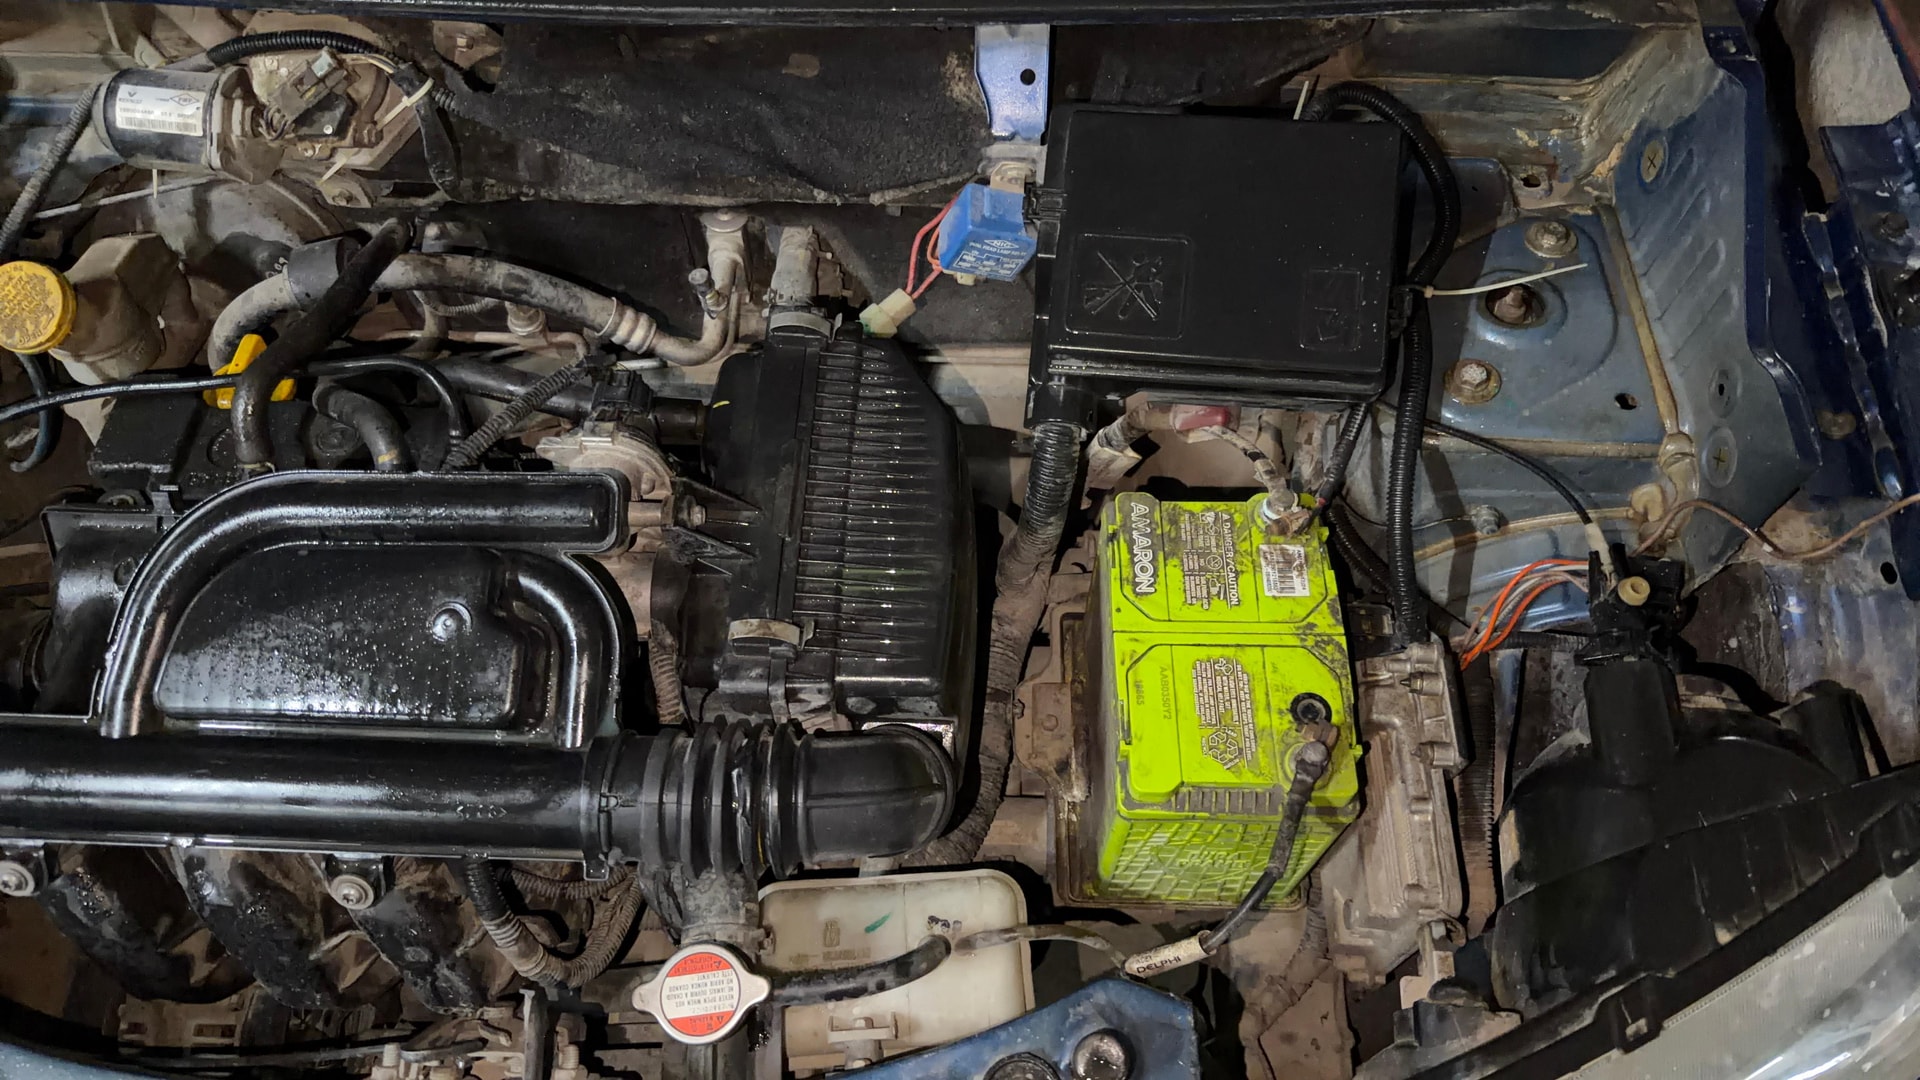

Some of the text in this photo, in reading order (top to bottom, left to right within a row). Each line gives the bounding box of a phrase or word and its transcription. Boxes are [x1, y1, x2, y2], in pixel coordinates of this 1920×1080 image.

[19, 329, 43, 345] OPEN
[1130, 502, 1156, 593] AMARON
[1160, 666, 1172, 720] AAB0350Y2
[1136, 955, 1182, 974] DELPHI
